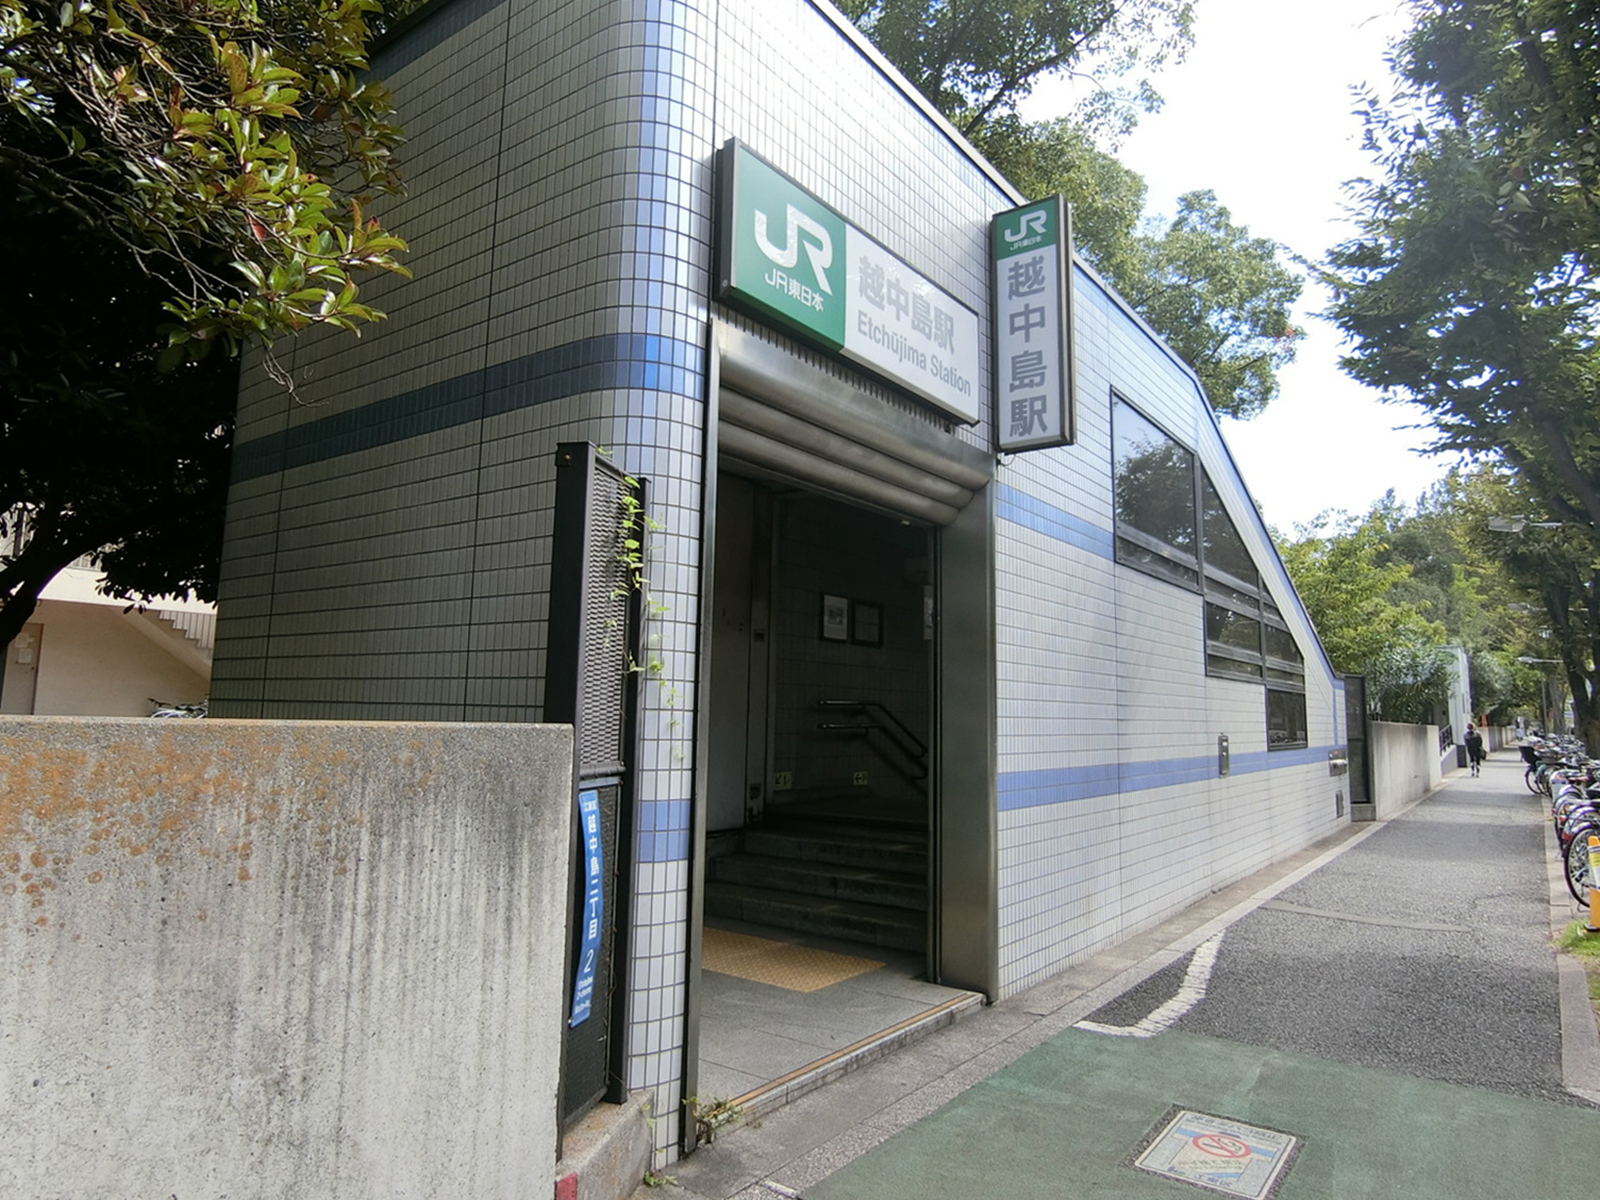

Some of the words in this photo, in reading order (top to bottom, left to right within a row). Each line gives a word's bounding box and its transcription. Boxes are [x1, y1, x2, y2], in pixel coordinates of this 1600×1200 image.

[754, 203, 833, 296] JR
[1004, 209, 1047, 243] JR
[764, 268, 824, 312] JR東日本
[858, 255, 955, 355] 越中島駅
[857, 309, 927, 363] Etchūjima
[930, 354, 972, 397] Station
[1007, 255, 1048, 437] 越中島駅
